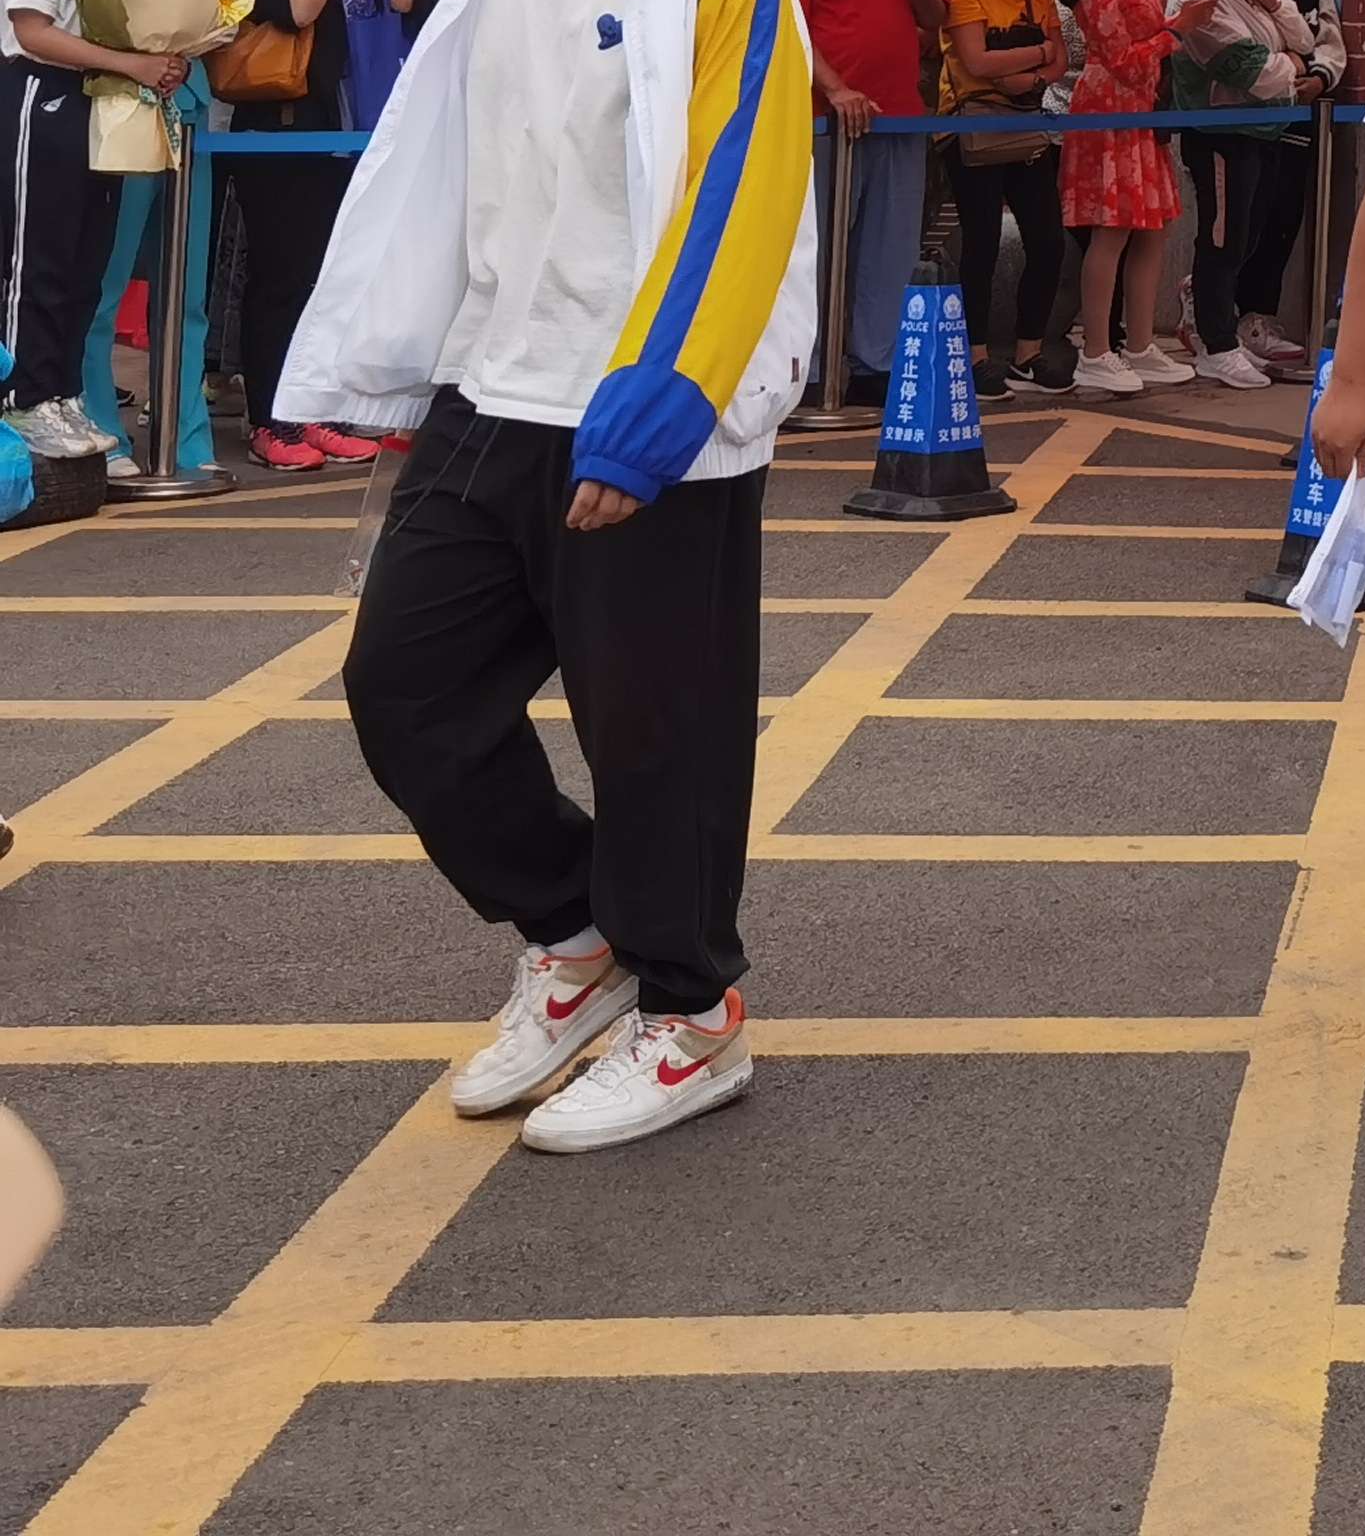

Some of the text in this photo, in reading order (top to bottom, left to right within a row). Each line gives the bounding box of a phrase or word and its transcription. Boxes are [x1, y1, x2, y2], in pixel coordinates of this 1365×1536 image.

[901, 321, 929, 333] POLICE
[938, 320, 967, 331] POLICE
[897, 336, 922, 424] 禁止停车
[946, 337, 969, 423] 违停拖移
